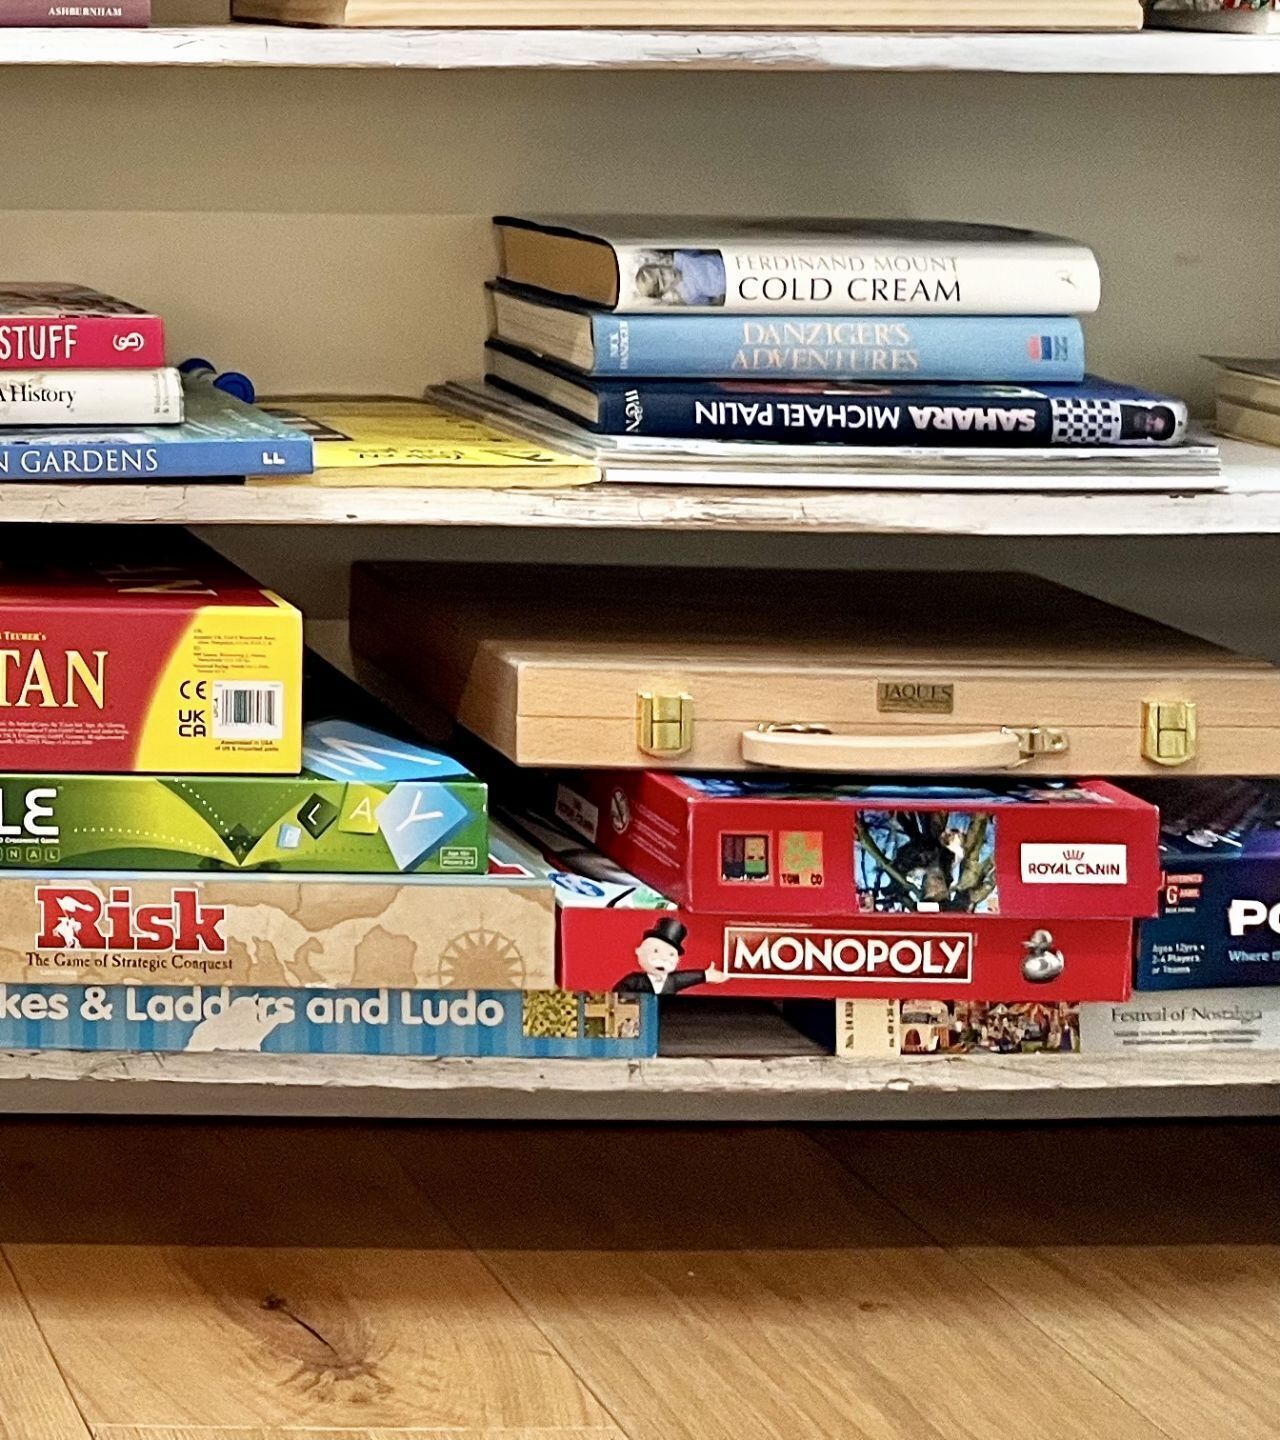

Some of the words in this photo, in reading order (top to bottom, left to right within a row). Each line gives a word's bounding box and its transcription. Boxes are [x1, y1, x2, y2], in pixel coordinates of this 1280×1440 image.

[48, 6, 123, 17] ASHBURNHAM
[735, 255, 865, 272] FERDINAND
[873, 256, 959, 273] MOUNT
[738, 276, 833, 302] COLD
[846, 277, 962, 302] CREAM
[742, 322, 911, 346] DANZIGER'S
[730, 347, 921, 370] ADVENTURES
[9, 384, 77, 410] History
[694, 400, 776, 426] PALIN
[777, 402, 900, 429] MICHAEL
[908, 406, 1038, 433] SAHARA
[25, 448, 159, 475] GARDENS
[178, 709, 206, 724] UK
[178, 724, 207, 738] CA
[1028, 863, 1072, 876] ROYAL
[1075, 863, 1120, 876] CANIN
[35, 885, 228, 954] Risk
[26, 952, 49, 966] The
[53, 953, 90, 967] Game
[94, 953, 108, 966] of
[111, 954, 168, 972] Strategic
[171, 955, 233, 973] Conquest
[733, 935, 966, 975] MONOPOLY
[1228, 950, 1271, 962] Where
[79, 985, 114, 1022] &
[306, 986, 389, 1024] and
[400, 988, 505, 1026] Ludo
[1111, 1006, 1167, 1023] Festival
[1171, 1007, 1186, 1022] of
